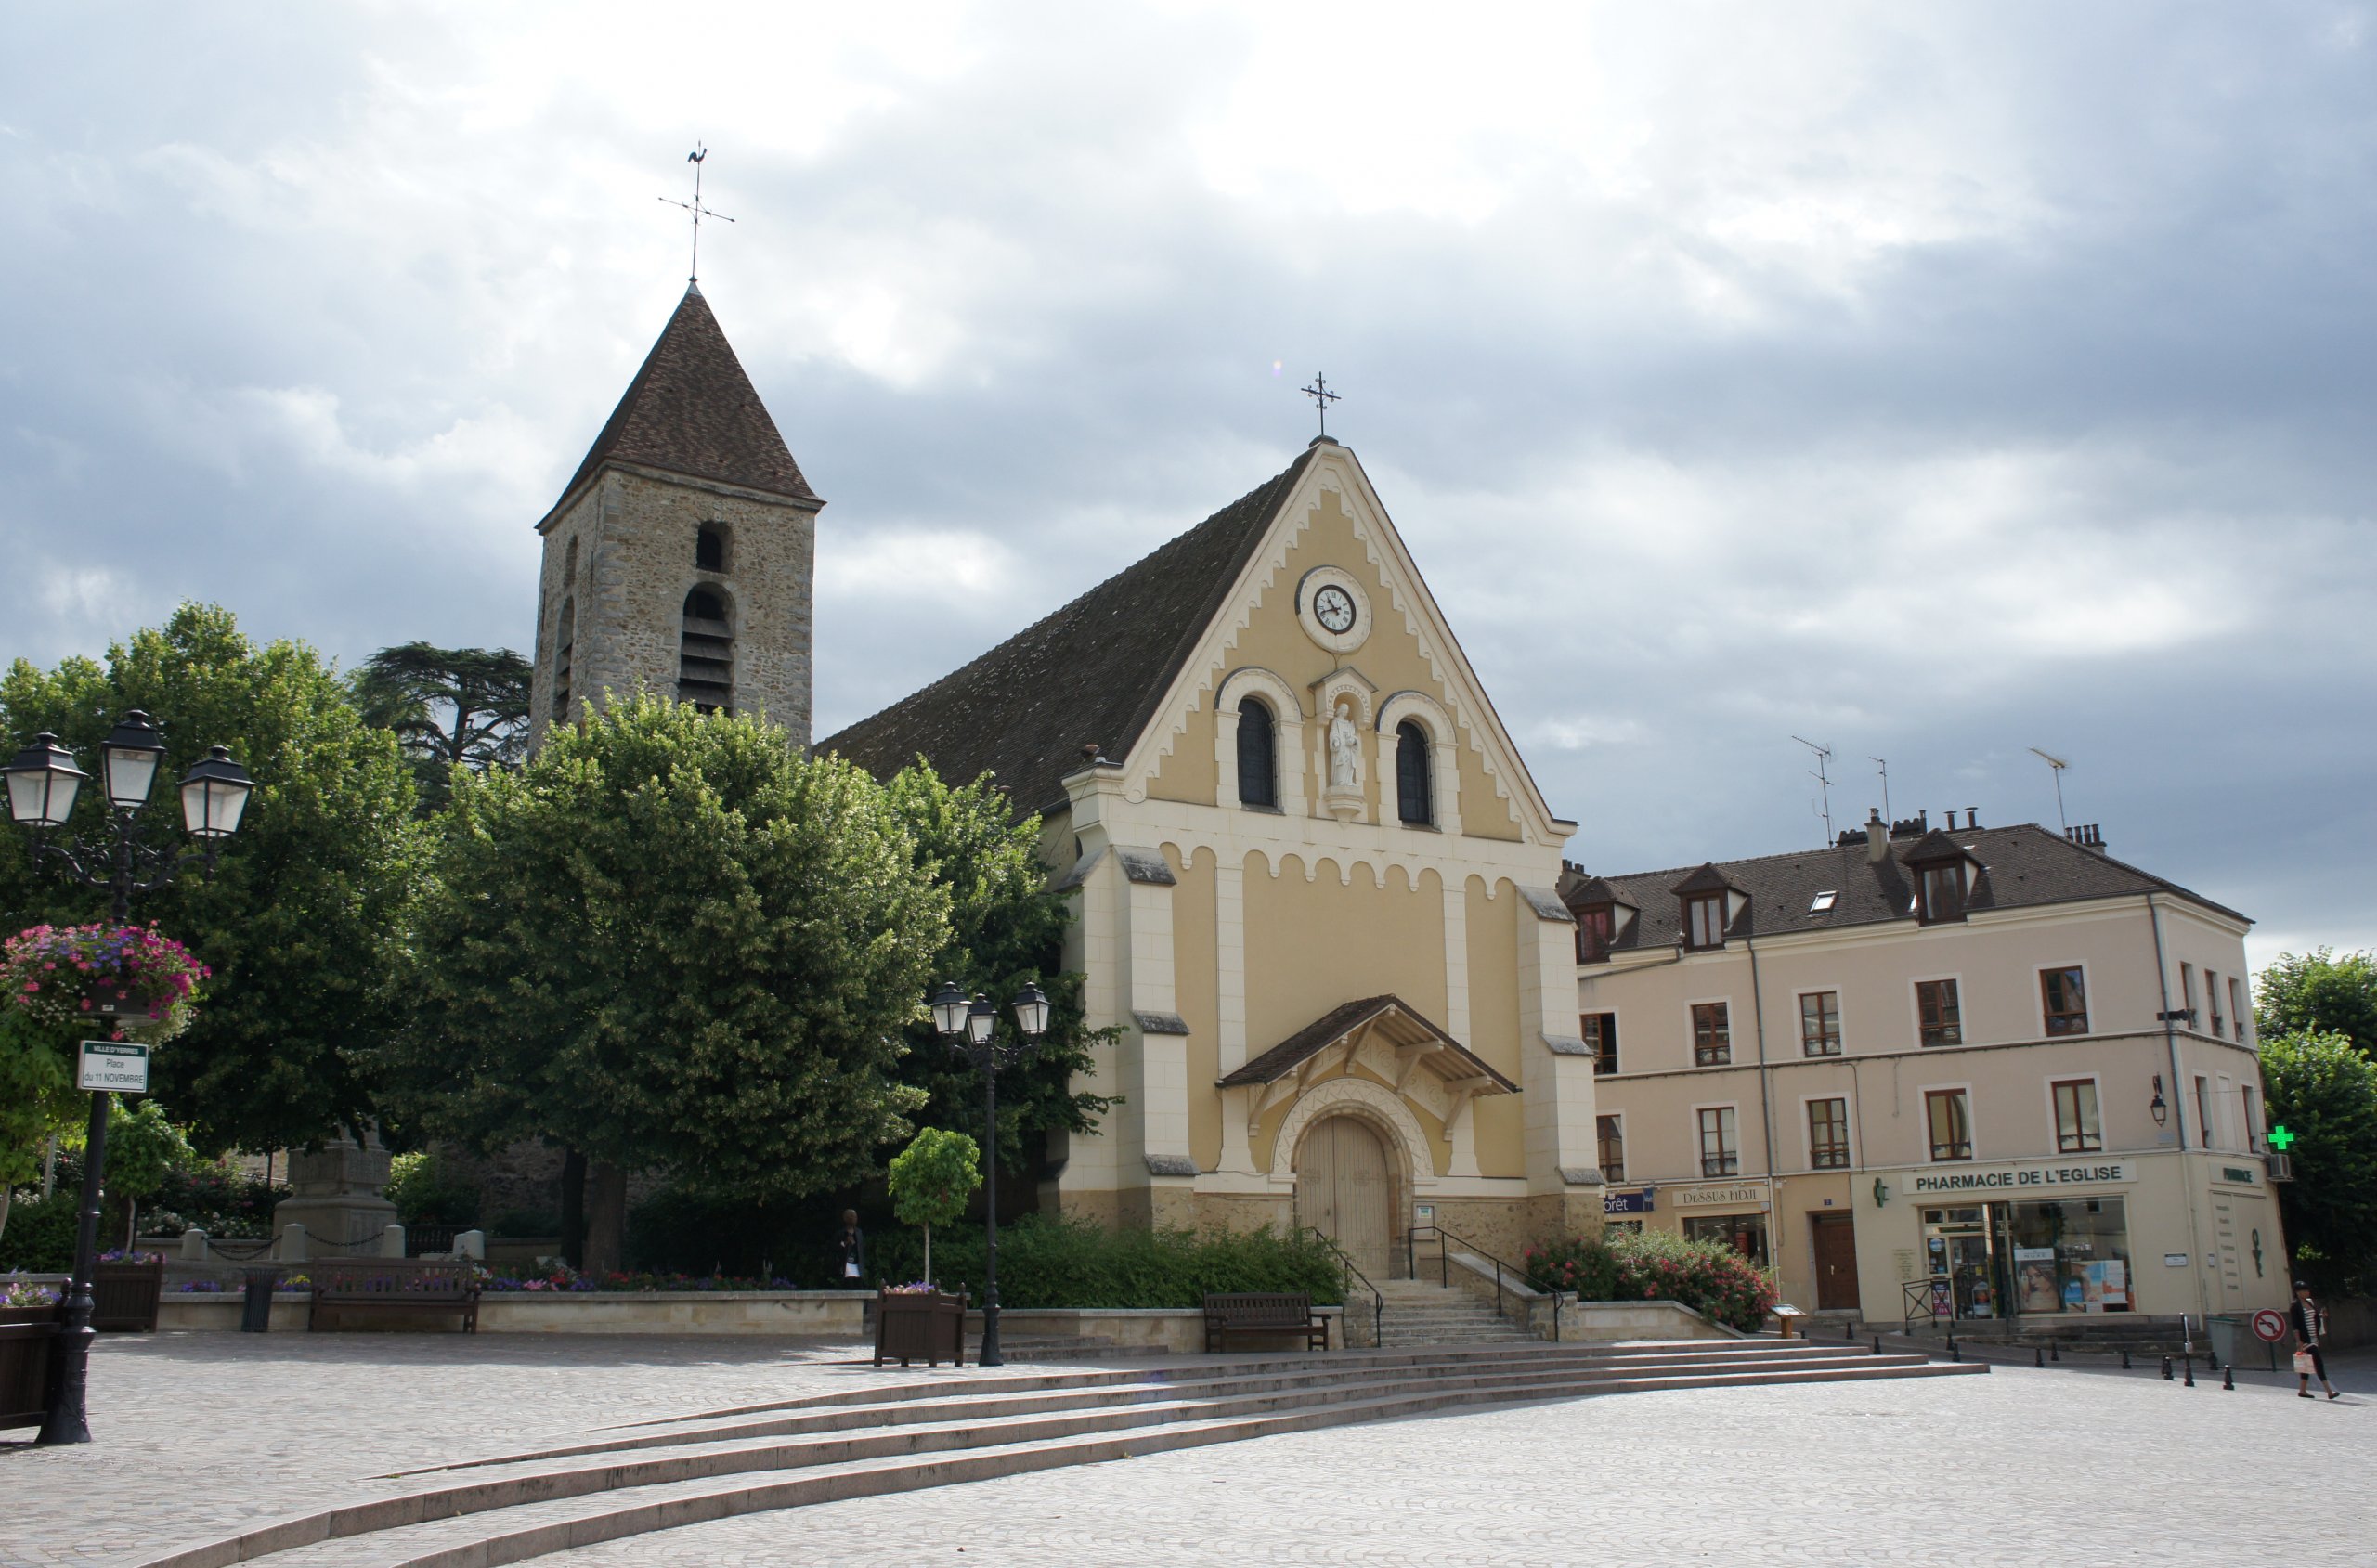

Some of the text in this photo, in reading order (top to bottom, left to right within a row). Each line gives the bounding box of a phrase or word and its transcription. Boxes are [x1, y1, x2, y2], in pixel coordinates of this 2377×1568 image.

[106, 1058, 124, 1069] Place
[95, 1073, 102, 1082] 11
[104, 1073, 144, 1084] NOVEMBRE
[1916, 1166, 2122, 1190] PHARMACIE DE L'EGLISE
